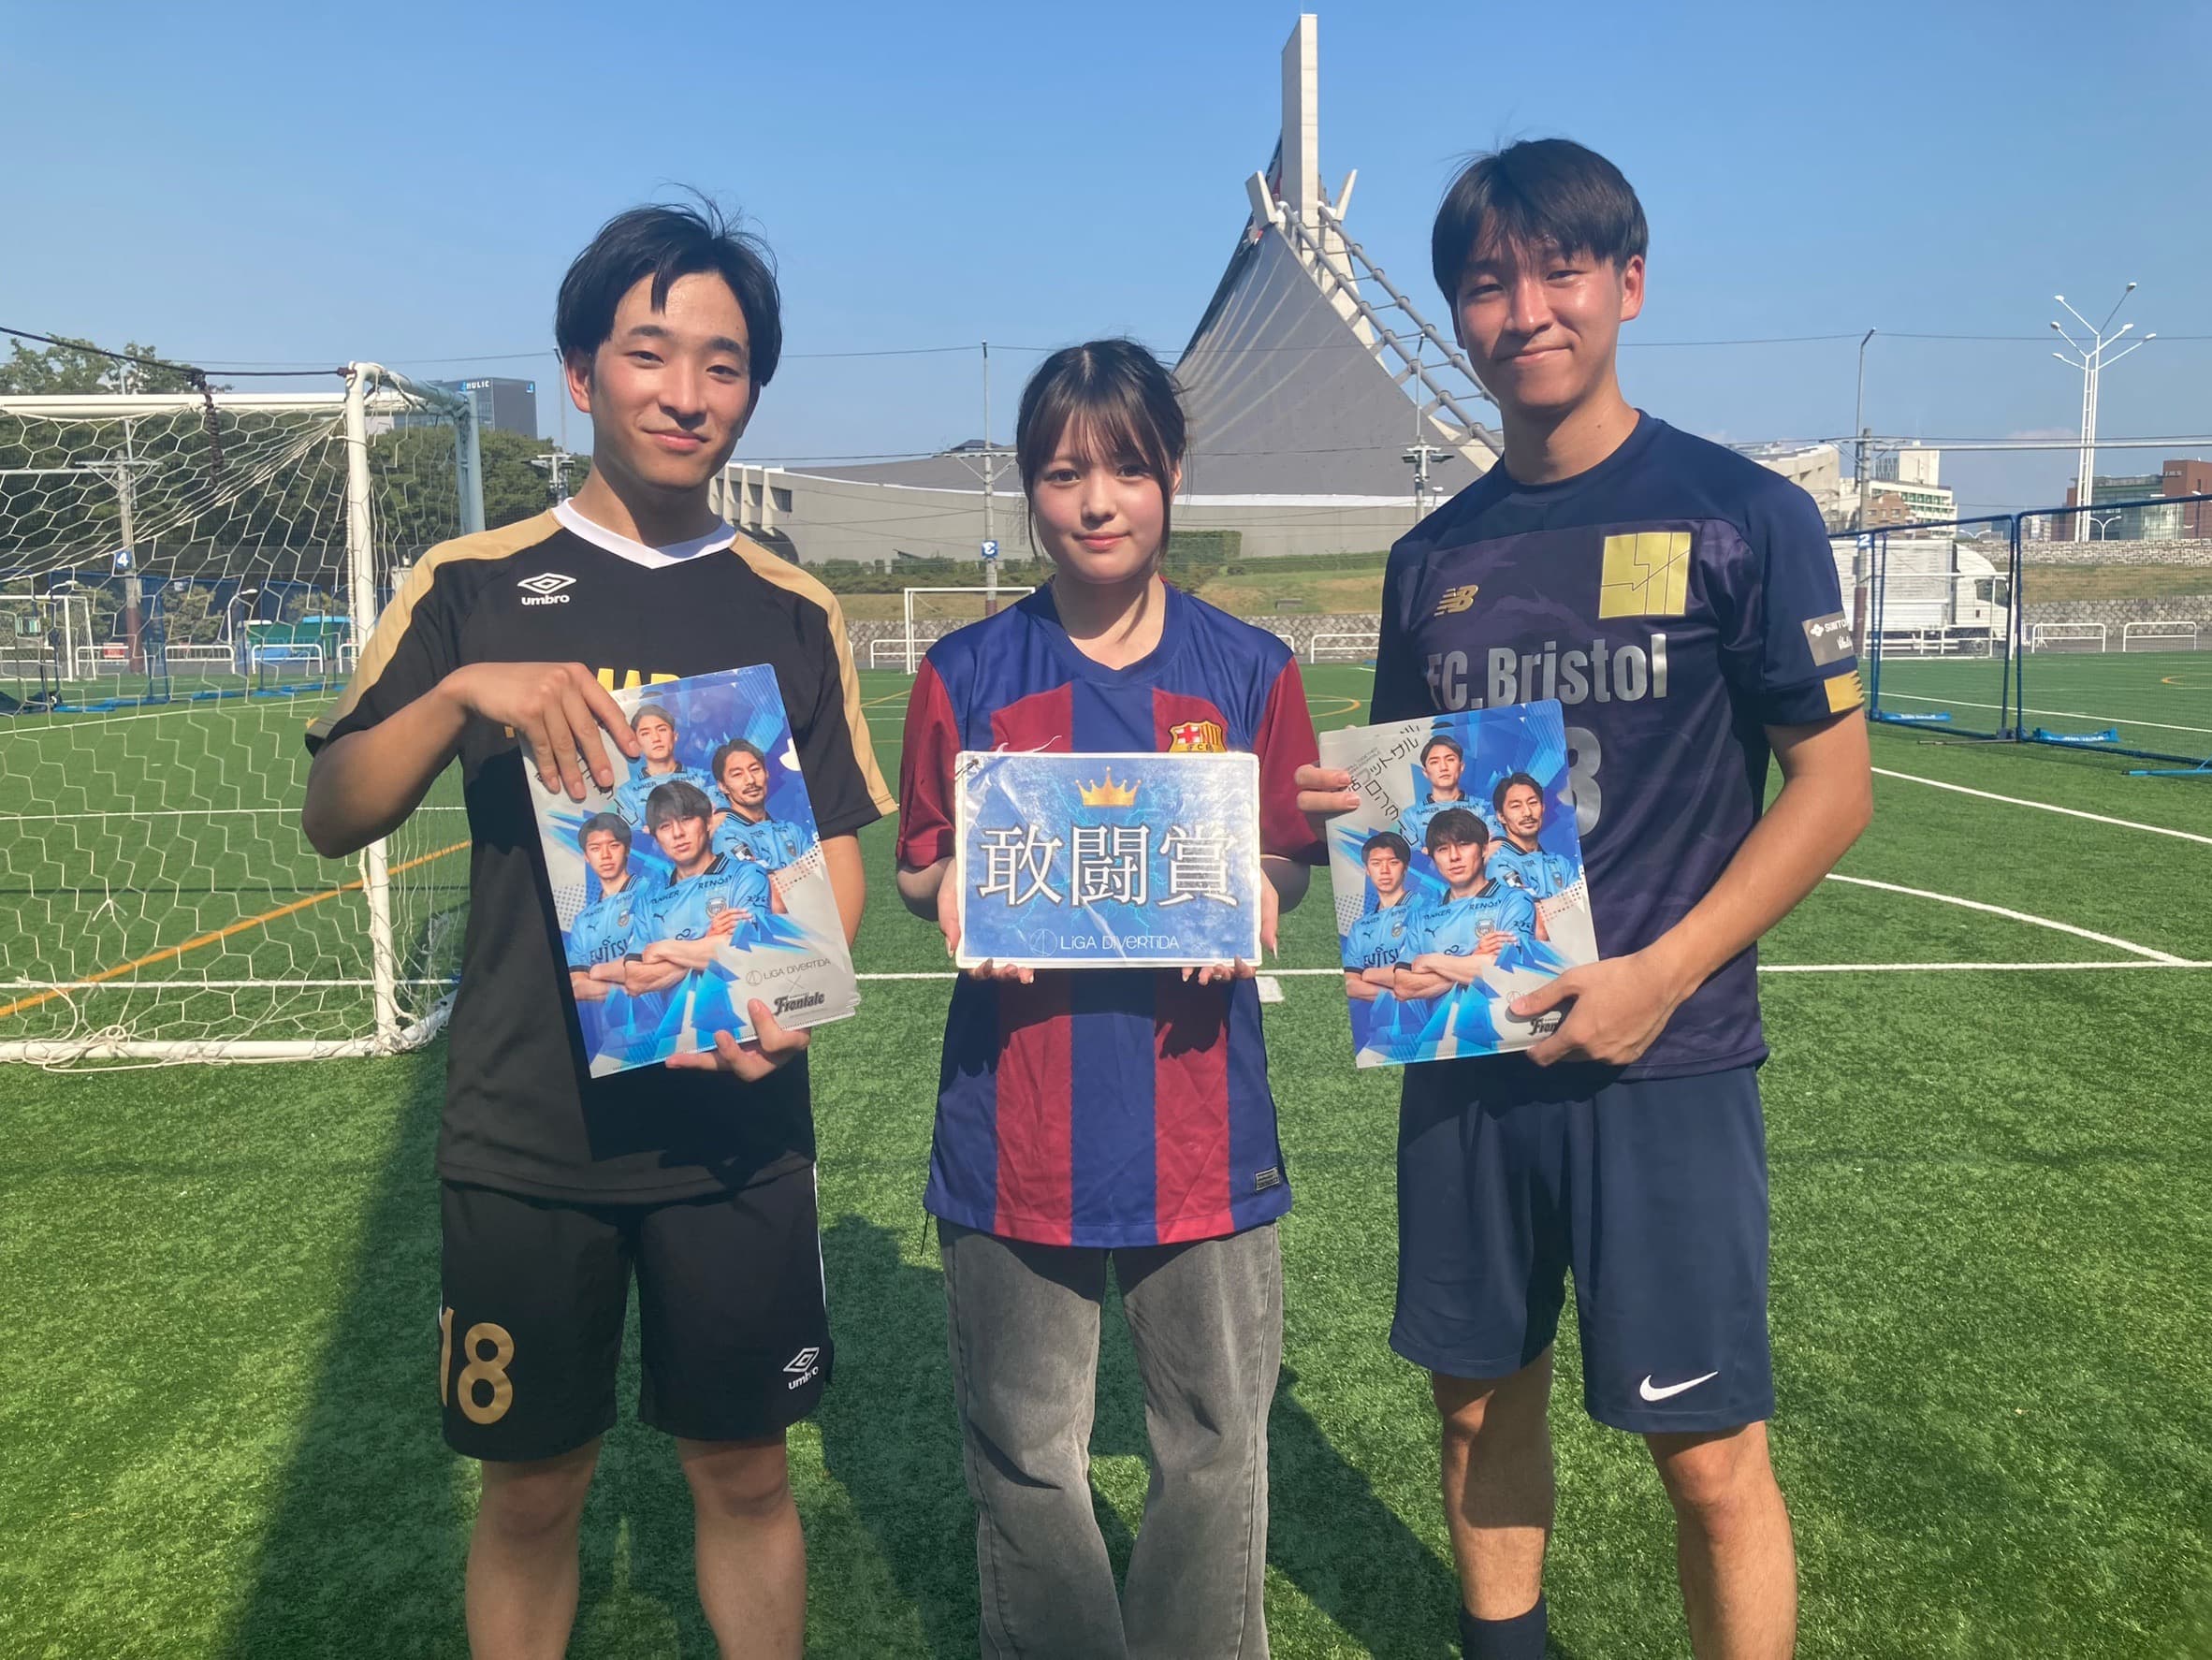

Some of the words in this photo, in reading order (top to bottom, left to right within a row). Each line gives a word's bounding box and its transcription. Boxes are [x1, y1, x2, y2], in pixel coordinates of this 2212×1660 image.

[467, 380, 490, 390] HULIC
[1858, 533, 1871, 546] 2
[117, 552, 129, 567] 4
[520, 593, 571, 606] umbro
[977, 822, 1240, 907] 敢闘賞
[774, 991, 826, 1016] Frontale
[440, 1306, 516, 1425] 18
[788, 1366, 820, 1391] umbo
